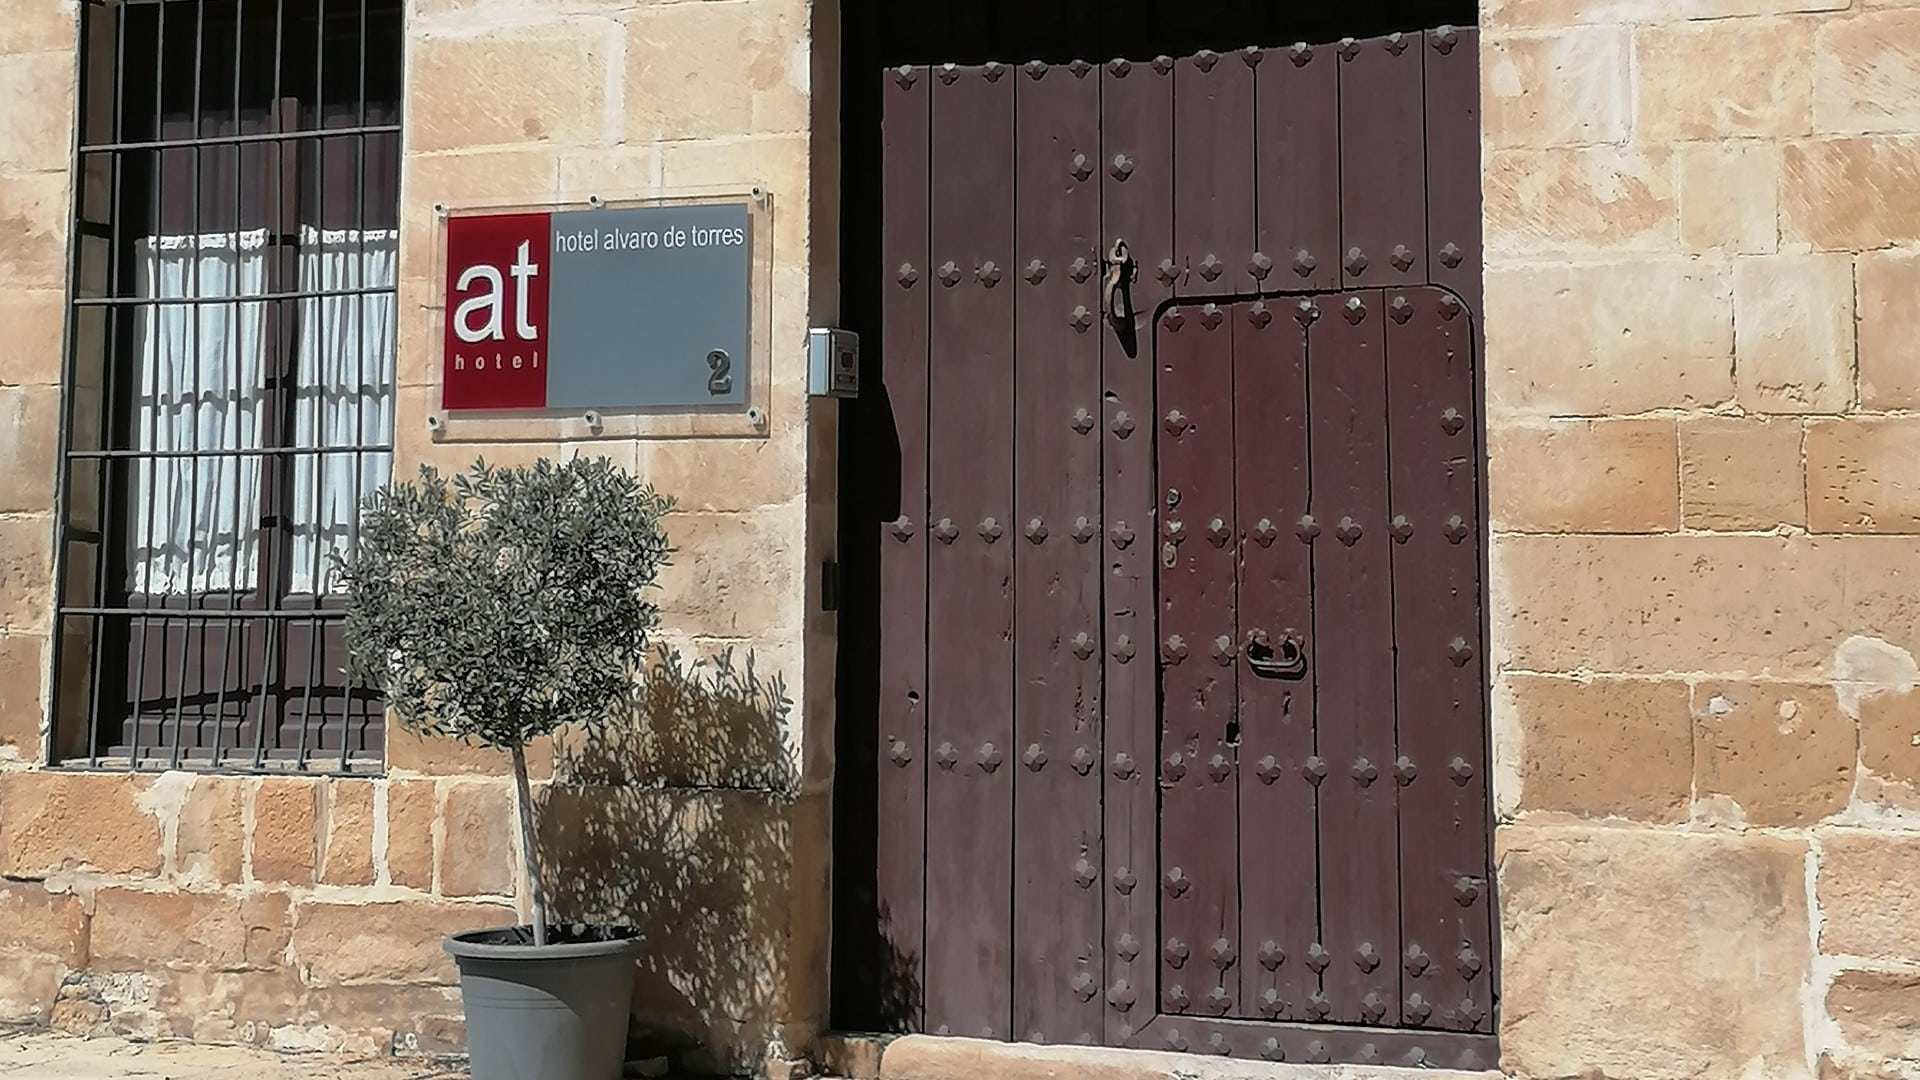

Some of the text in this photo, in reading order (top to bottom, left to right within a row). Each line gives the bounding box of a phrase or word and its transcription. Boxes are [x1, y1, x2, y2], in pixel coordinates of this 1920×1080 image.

[555, 225, 744, 253] hotel alvaro de torres
[454, 239, 539, 343] at
[454, 351, 538, 370] hotel
[706, 348, 732, 397] 2
